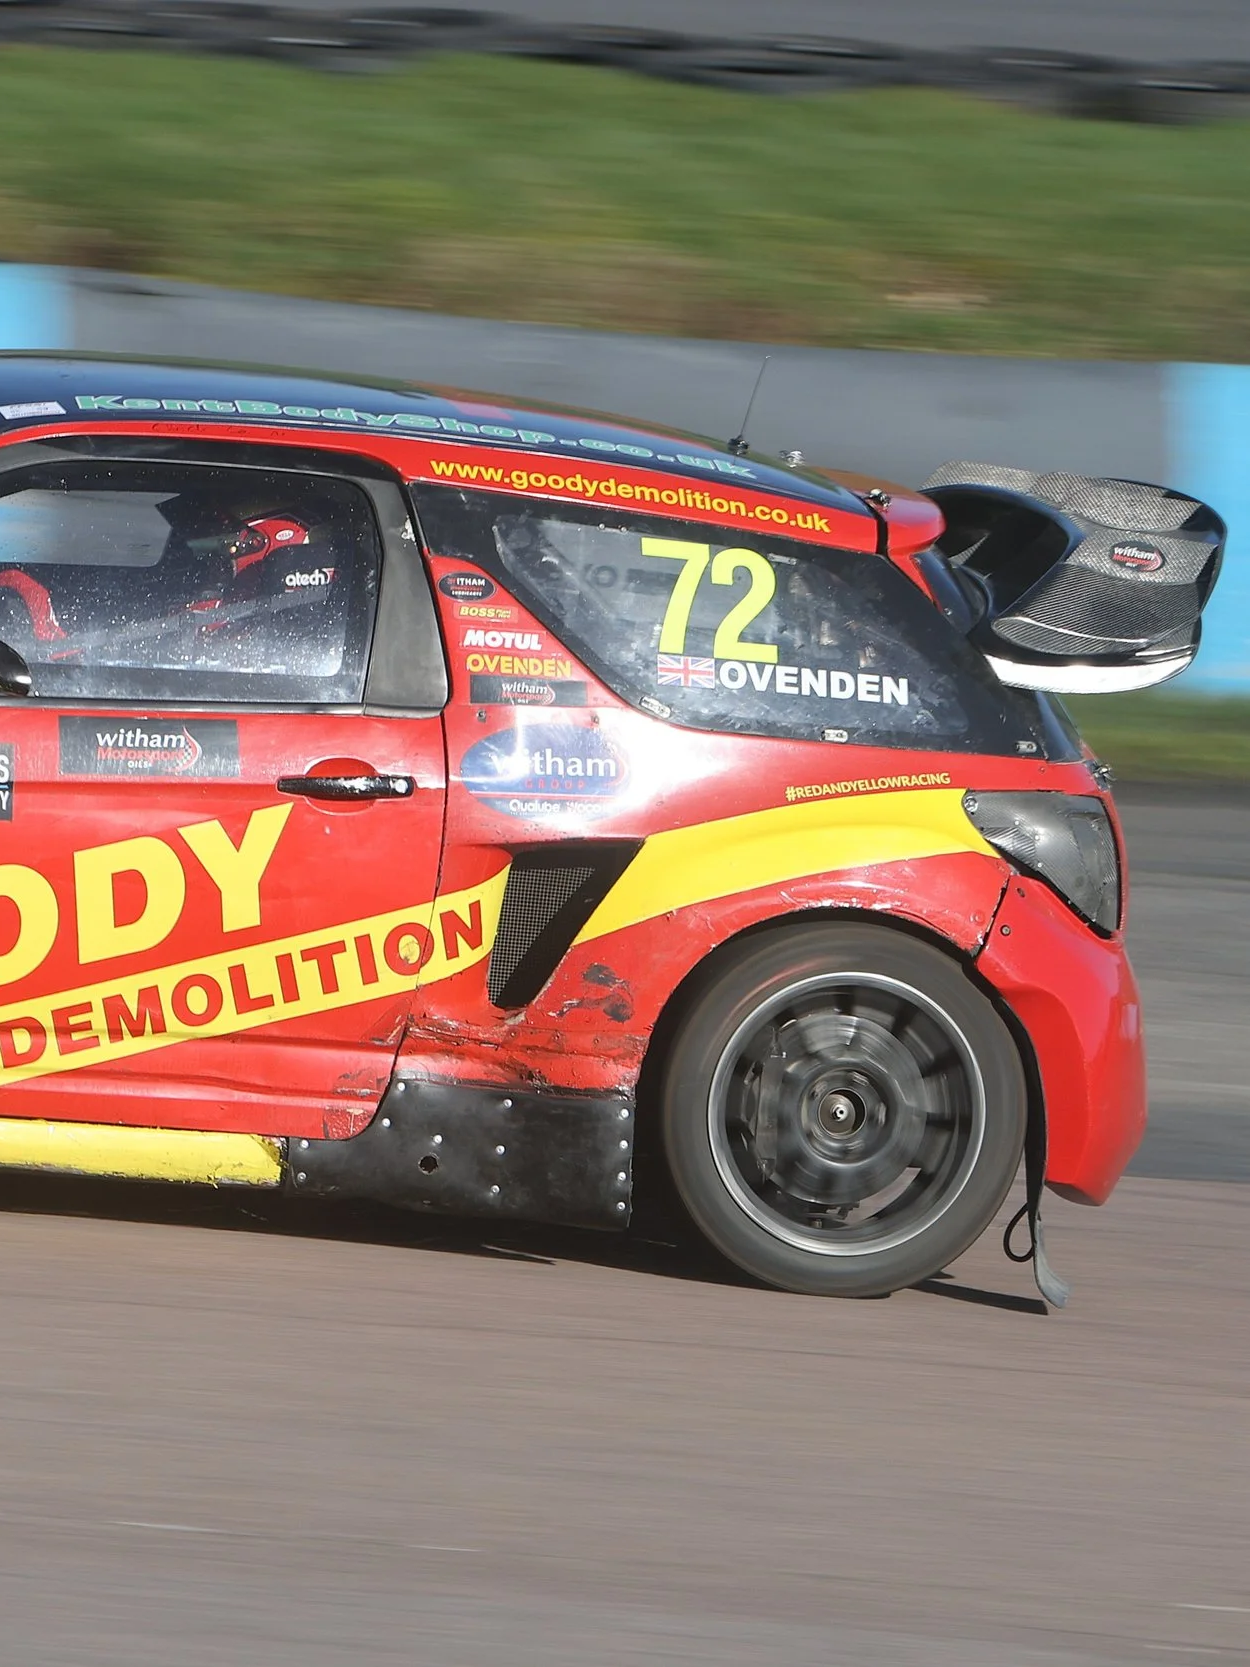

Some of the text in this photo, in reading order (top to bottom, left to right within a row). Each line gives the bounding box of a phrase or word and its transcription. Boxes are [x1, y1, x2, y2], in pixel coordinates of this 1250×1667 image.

[75, 395, 756, 479] KentBodyShop.co.uk
[430, 459, 832, 533] www.goodydemolition.co.uk
[1114, 546, 1154, 561] witham
[460, 606, 495, 618] BOSS
[641, 537, 778, 664] 72
[464, 630, 543, 650] MOTUL
[467, 654, 572, 678] OVENDEN
[502, 682, 548, 694] witham
[719, 660, 909, 706] OVENDEN
[96, 728, 185, 748] witham
[785, 773, 951, 802] #REDANDYELLOWRACING
